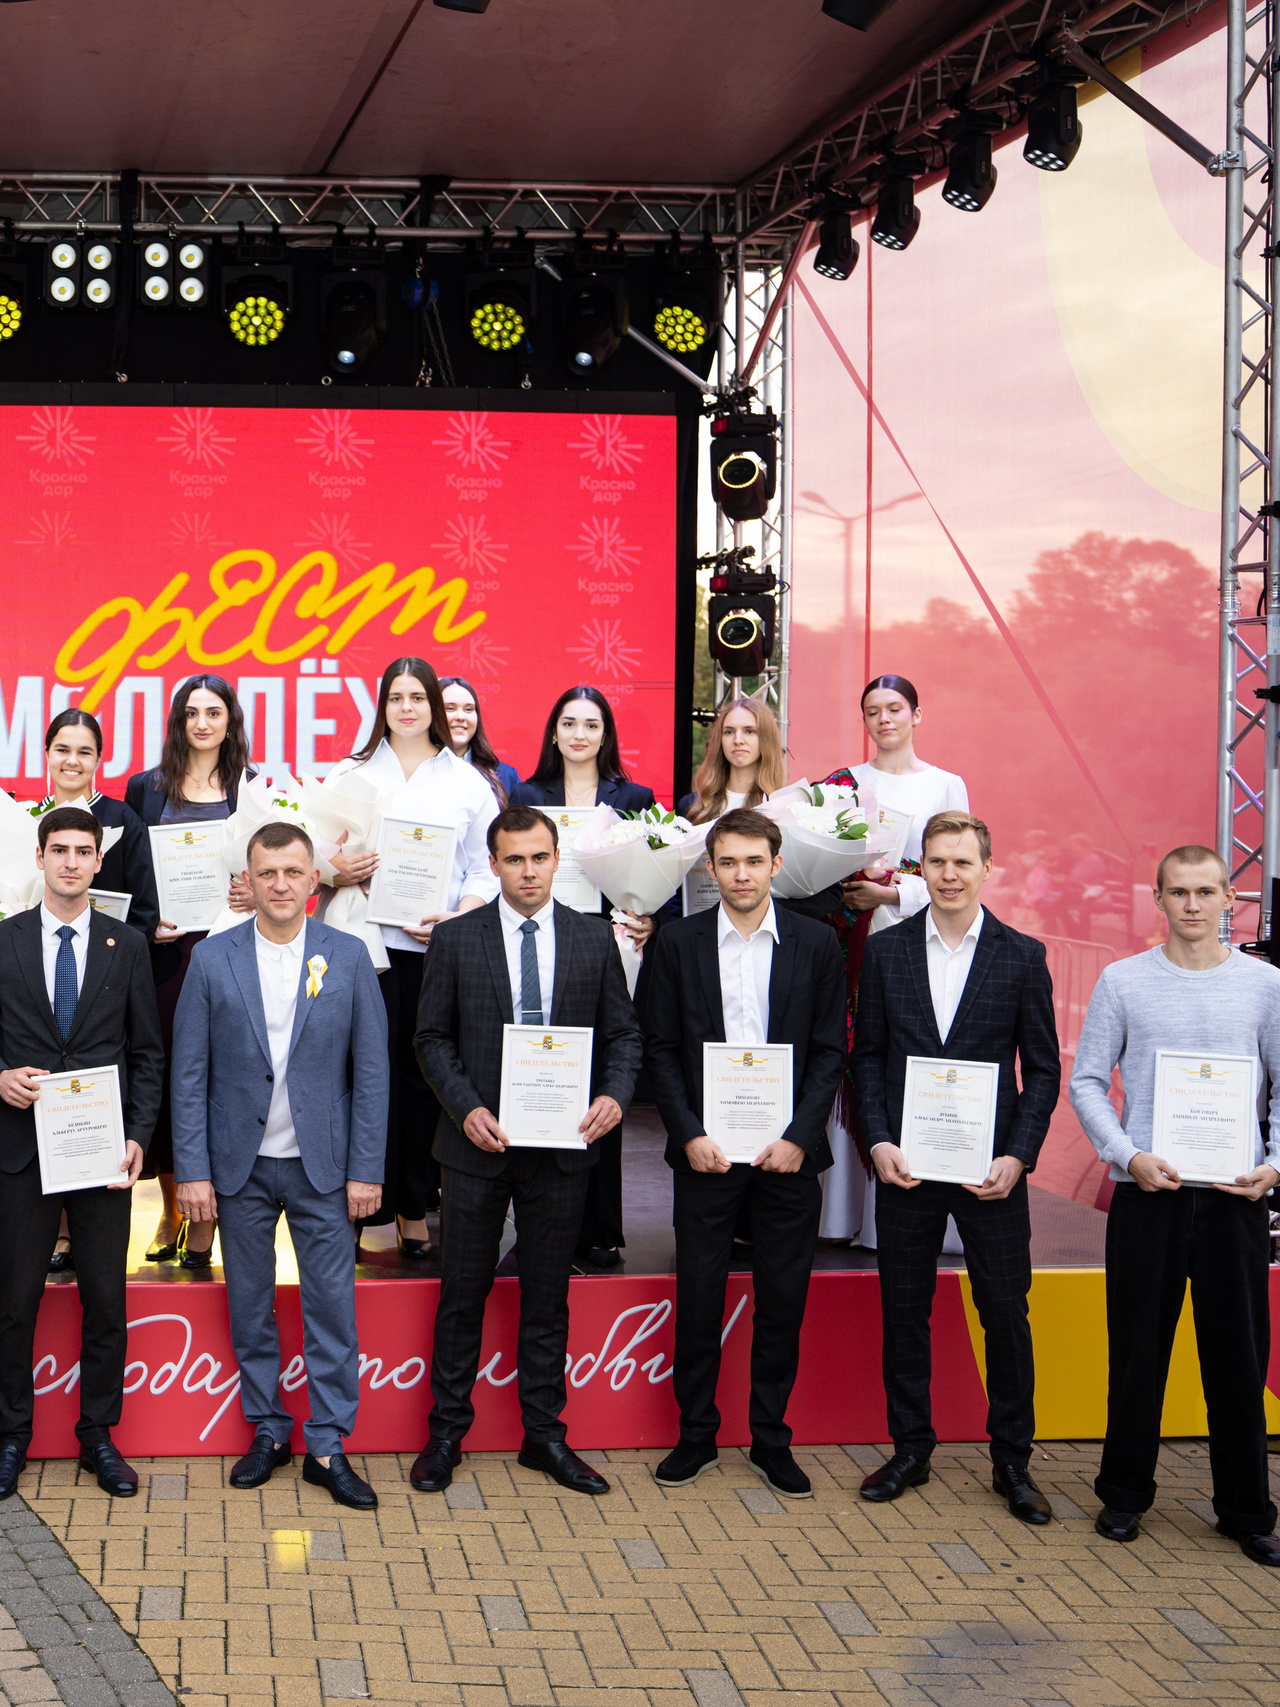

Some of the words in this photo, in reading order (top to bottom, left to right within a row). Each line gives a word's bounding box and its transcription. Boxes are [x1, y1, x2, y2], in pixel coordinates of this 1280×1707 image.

[29, 469, 88, 486] Красно
[169, 470, 228, 487] Красно
[308, 472, 366, 488] Красно
[445, 473, 502, 490] Красно
[579, 475, 636, 492] Красно
[43, 483, 73, 498] дар
[183, 484, 213, 499] дар
[322, 485, 352, 501] дар
[458, 488, 488, 503] дар
[593, 489, 622, 505] дар
[577, 577, 634, 594] Красно
[591, 592, 620, 606] дар
